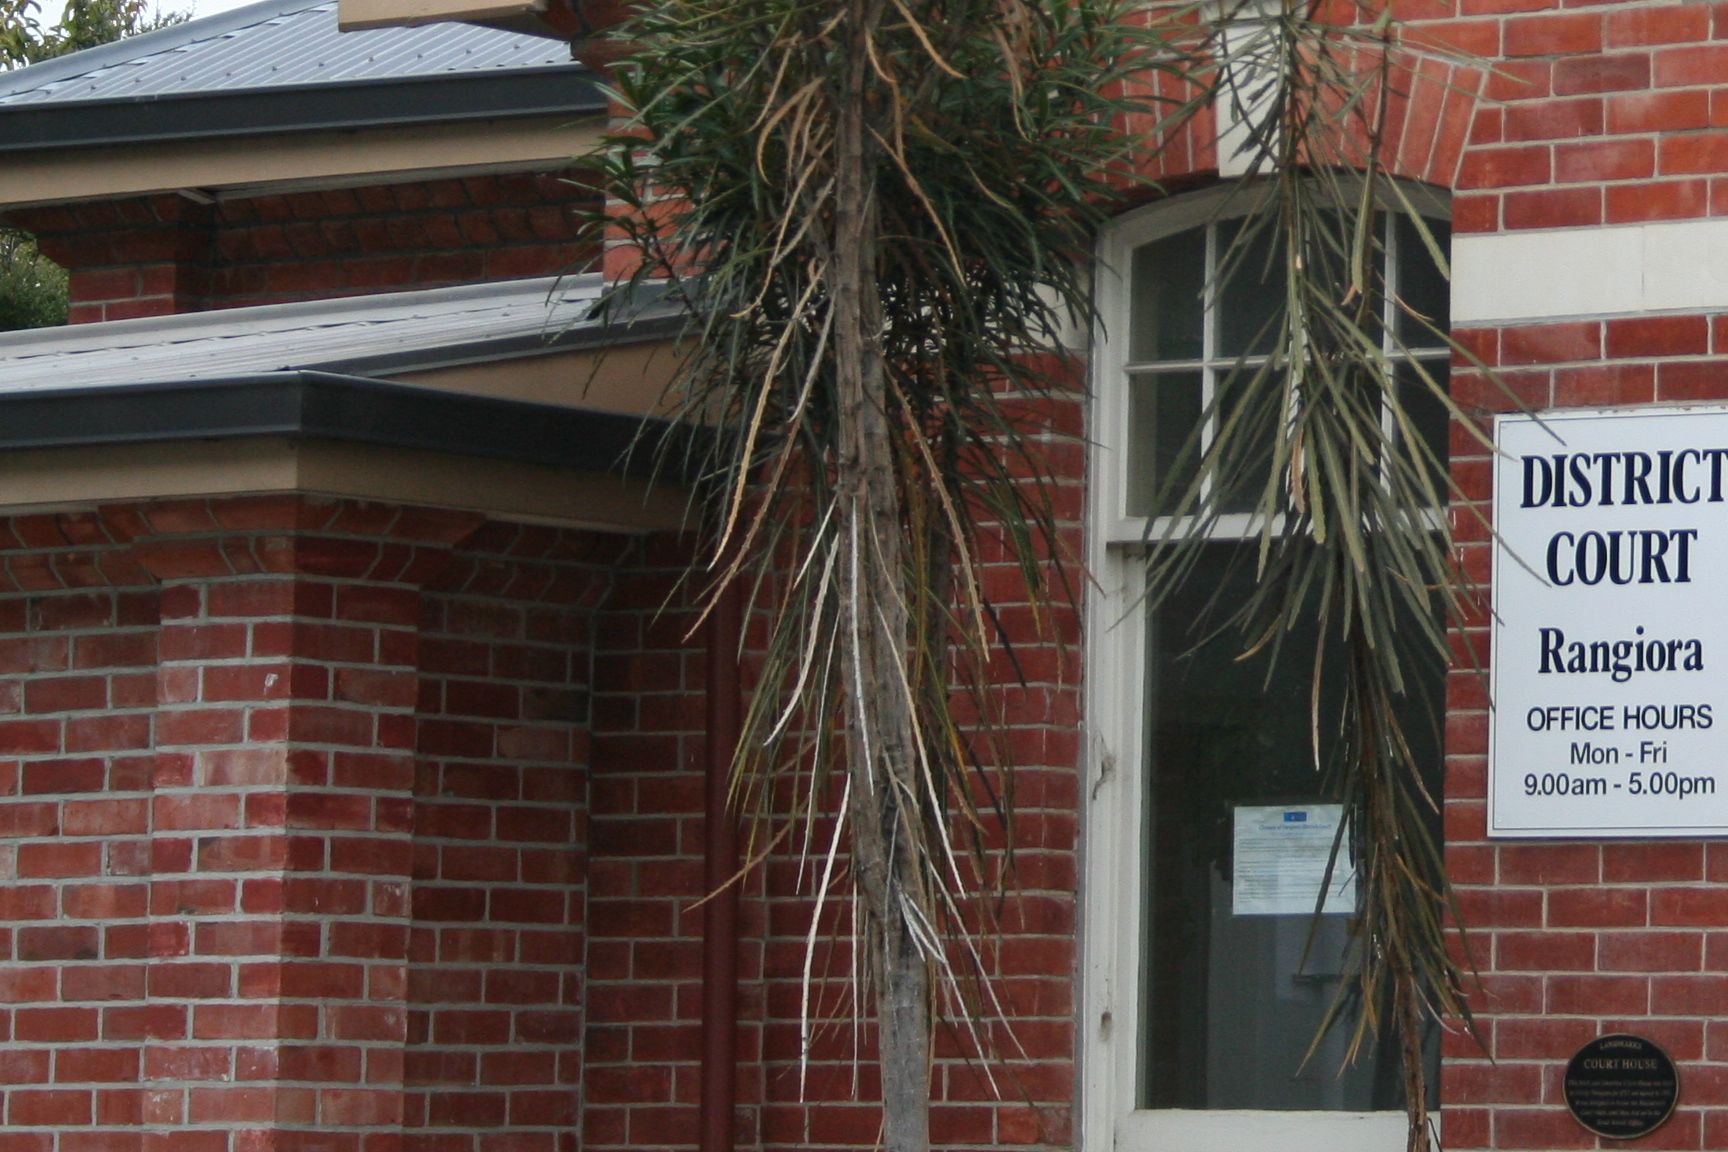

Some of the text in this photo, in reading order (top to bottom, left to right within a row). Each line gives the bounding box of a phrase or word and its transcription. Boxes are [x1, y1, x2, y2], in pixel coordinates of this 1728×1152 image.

[1546, 529, 1698, 587] COURT
[1538, 625, 1704, 683] Rangiora
[1526, 703, 1713, 732] OFFICE HOURS
[1570, 741, 1619, 765] Mon
[1640, 740, 1667, 764] Fri
[1524, 772, 1607, 796] 9.00am
[1628, 771, 1715, 800] 5.00pm
[1583, 1058, 1658, 1069] COURT HOUSE
